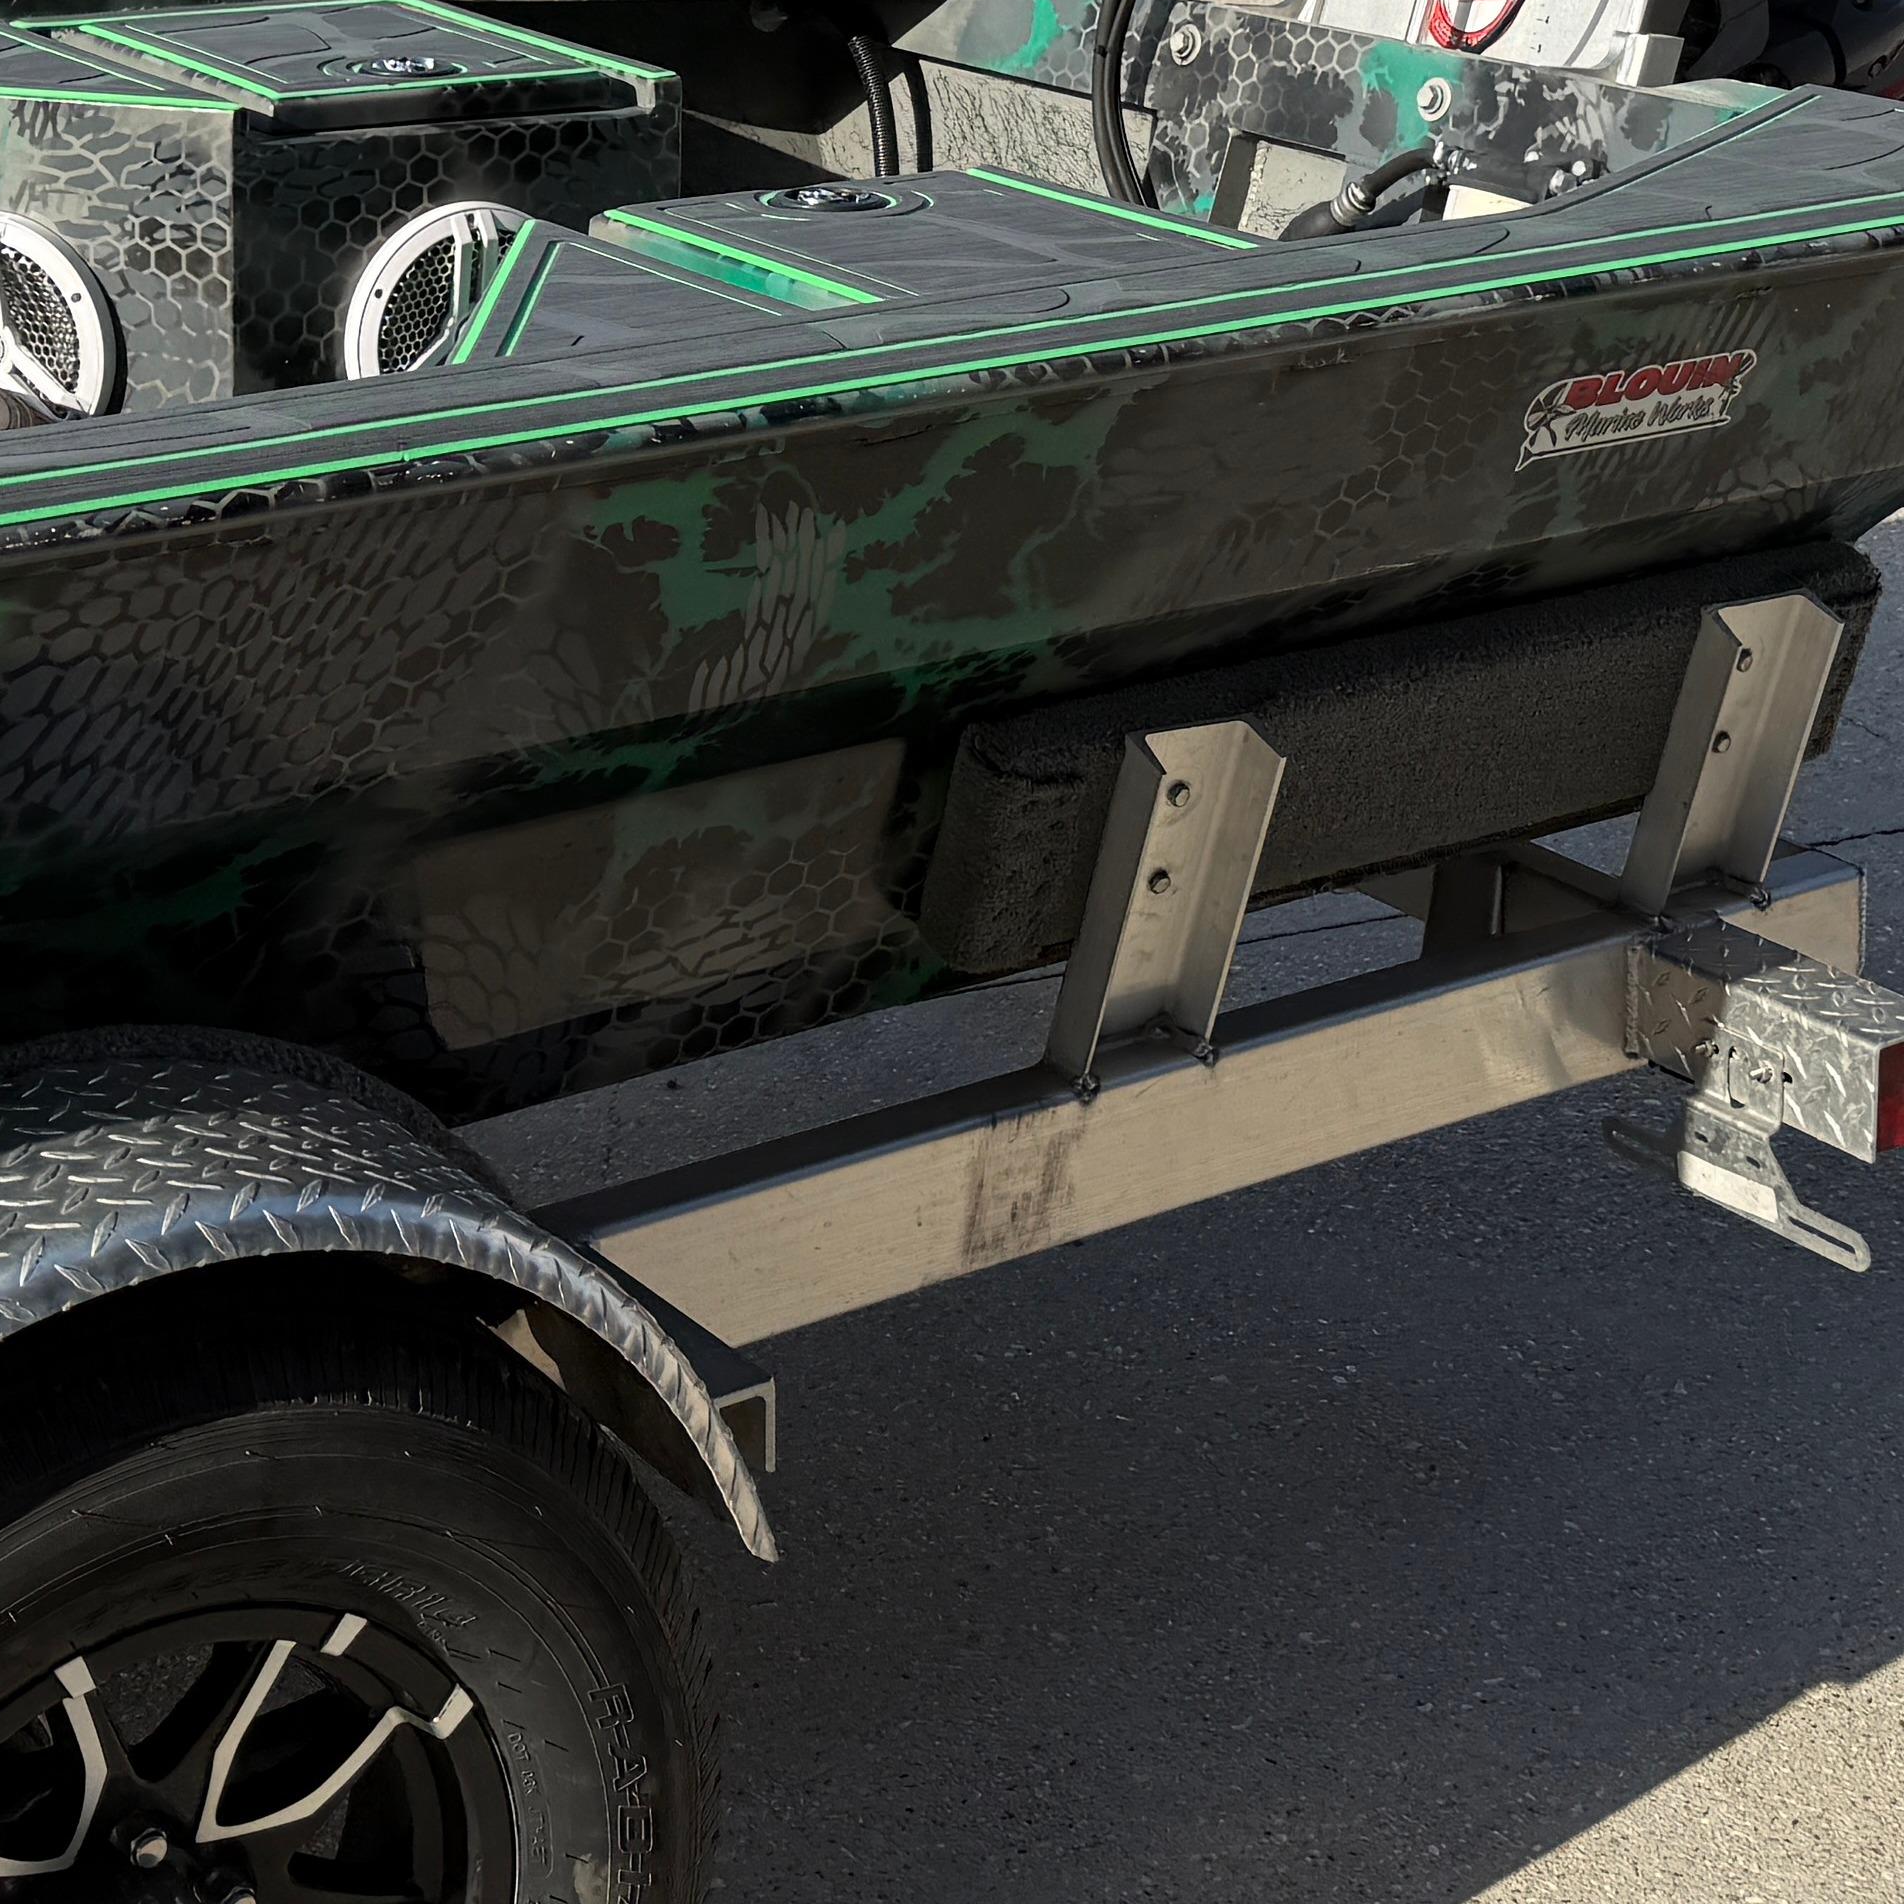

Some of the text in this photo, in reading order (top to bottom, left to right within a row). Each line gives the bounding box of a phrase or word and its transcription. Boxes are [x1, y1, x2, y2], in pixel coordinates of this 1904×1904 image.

[1565, 353, 1744, 410] BLOUIN
[1565, 396, 1715, 442] Marine Works
[587, 1682, 654, 1904] RADI
